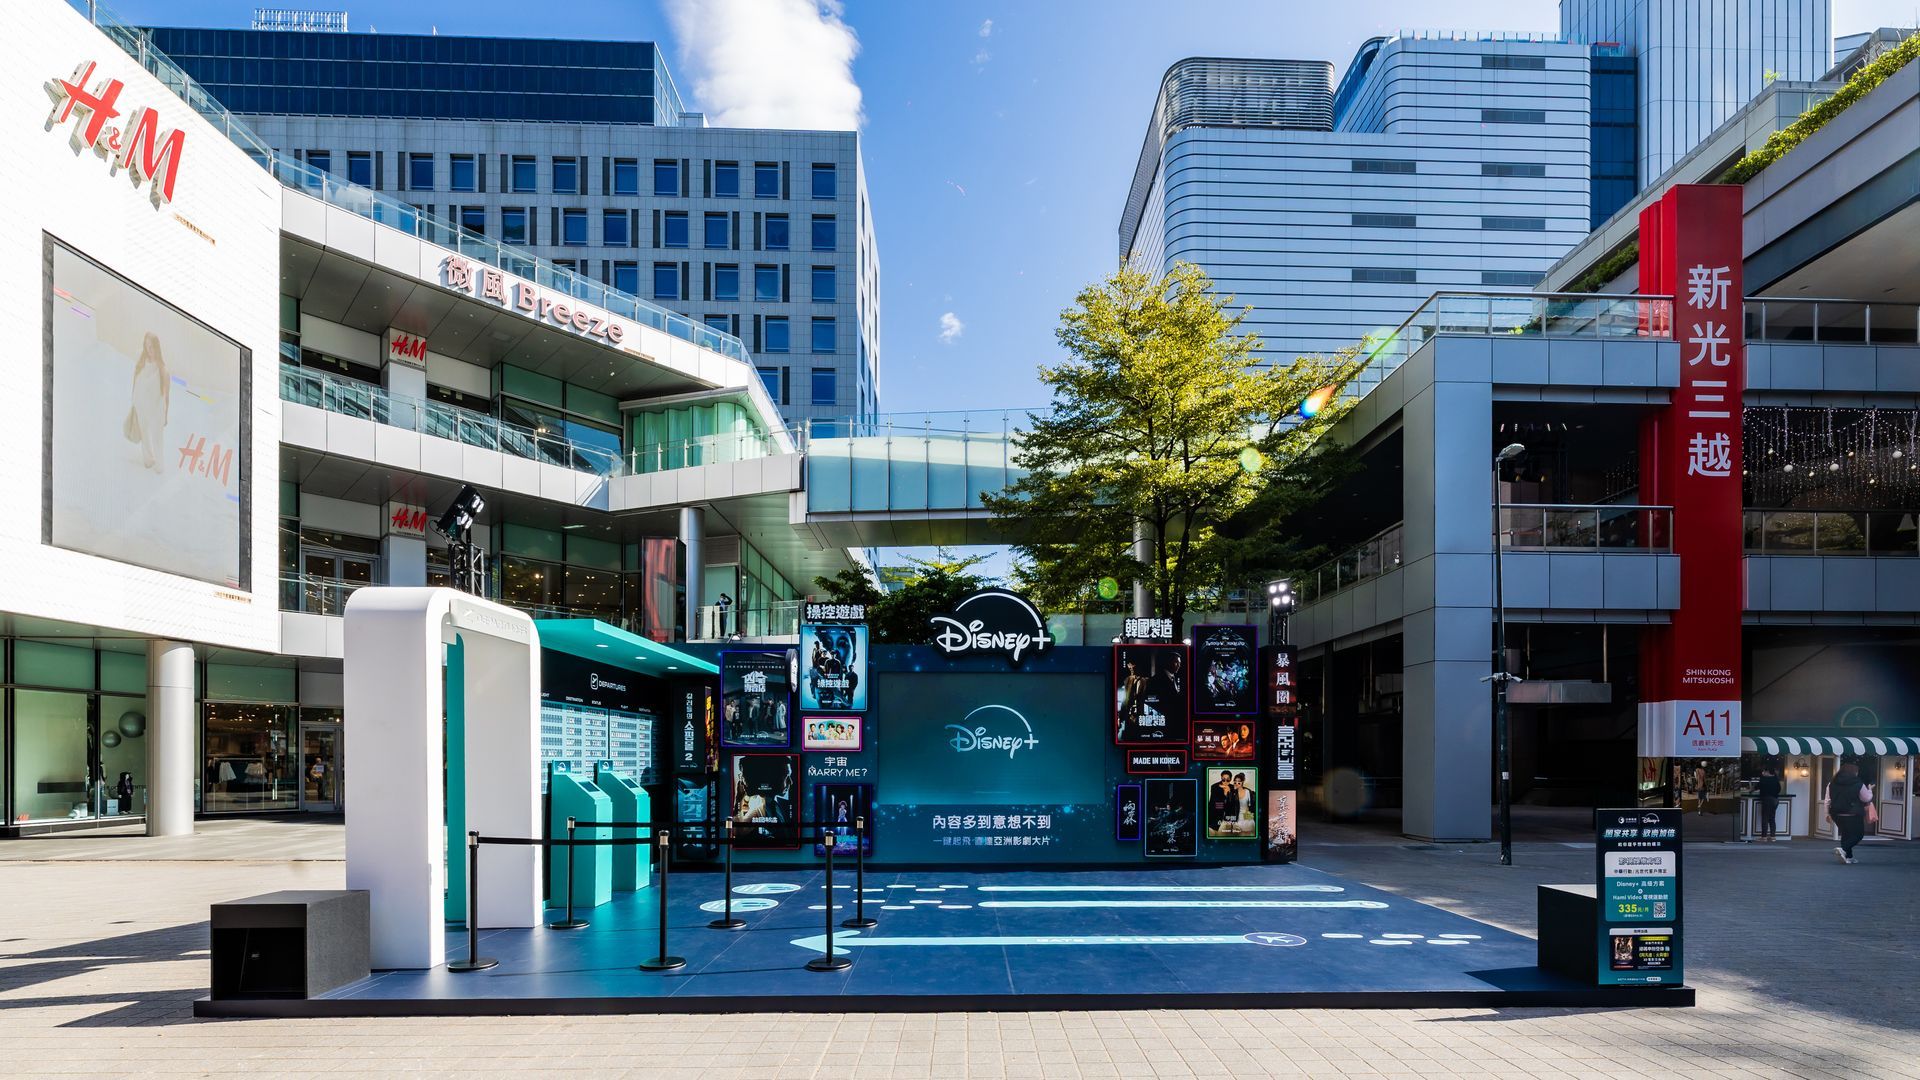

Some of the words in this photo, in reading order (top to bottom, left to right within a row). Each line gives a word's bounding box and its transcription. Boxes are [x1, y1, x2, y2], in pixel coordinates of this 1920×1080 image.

[59, 60, 186, 203] H&M
[446, 255, 508, 305] 微風
[516, 281, 624, 344] Breeze
[391, 334, 427, 362] H&M
[1687, 263, 1732, 478] 新光三越
[178, 432, 233, 488] H&M
[391, 507, 428, 533] H&M
[806, 604, 865, 620] 操控遊戲
[930, 616, 1051, 662] Disney+
[1125, 618, 1173, 638] 韓國製造
[599, 680, 627, 692] DEPARTURES
[1276, 653, 1291, 705] 暴風圈
[1682, 709, 1730, 736] A11
[944, 724, 1039, 760] Disney+
[684, 753, 693, 761] 2
[824, 756, 848, 767] 宇宙
[1133, 757, 1151, 765] MADE
[1152, 757, 1159, 765] IN
[1159, 757, 1181, 765] KOREA
[808, 766, 844, 777] MARRY
[932, 814, 1052, 830] 內容多到意想不到
